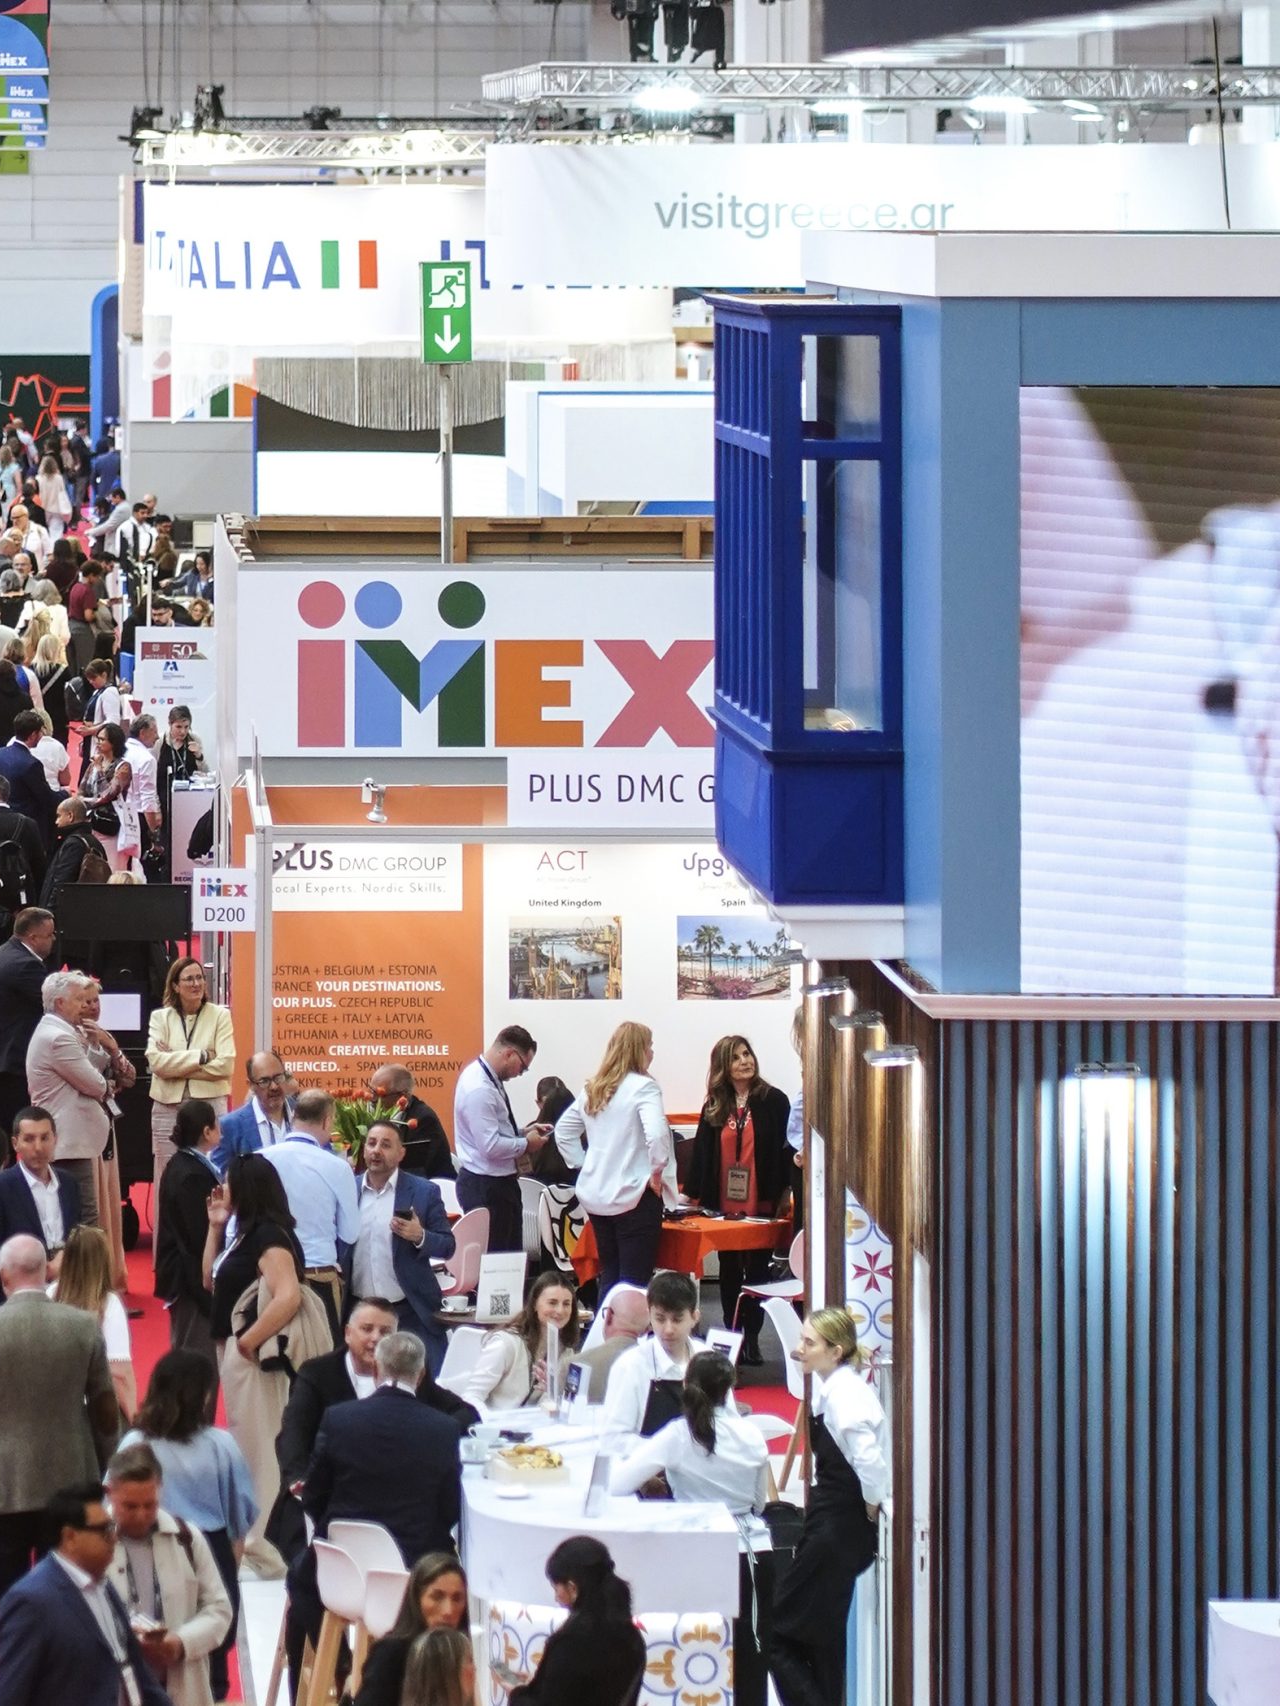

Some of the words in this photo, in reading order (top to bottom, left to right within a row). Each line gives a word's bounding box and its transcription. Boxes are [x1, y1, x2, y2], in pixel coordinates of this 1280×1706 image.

[529, 774, 602, 803] PLUS
[618, 774, 684, 803] DMC
[698, 774, 715, 803] G
[340, 857, 378, 871] DMC
[384, 857, 447, 871] GROUP
[537, 850, 588, 871] ACT
[683, 852, 730, 877] Upg
[273, 883, 300, 893] ocal
[306, 883, 355, 895] Experts.
[362, 883, 404, 893] Nordic
[410, 882, 446, 893] Skills.
[528, 899, 559, 907] United
[561, 899, 602, 909] Kingdom
[721, 898, 746, 908] Spain
[204, 907, 246, 922] D200
[272, 965, 310, 976] USTRIA
[324, 965, 375, 976] BELGIUM
[388, 965, 437, 976] ESTONIA
[316, 981, 350, 992] YOUR
[352, 981, 445, 992] DESTINATIONS.
[272, 997, 299, 1008] OUR
[302, 997, 336, 1008] PLUS.
[339, 997, 376, 1008] CZECH
[380, 997, 434, 1008] REPUBLIC
[285, 1013, 328, 1024] GREECE
[342, 1013, 371, 1024] ITALY
[385, 1013, 425, 1024] LATVIA
[277, 1029, 339, 1040] LITHUANIA
[352, 1029, 433, 1040] LUXEMBOURG
[272, 1045, 326, 1056] SLOVAKIA
[328, 1045, 390, 1056] CREATIVE.
[392, 1045, 449, 1056] RELIABLE
[284, 1061, 340, 1072] RIENCED.
[406, 1061, 463, 1072] GERMANY
[298, 1077, 322, 1088] KIYE
[335, 1077, 356, 1088] THE
